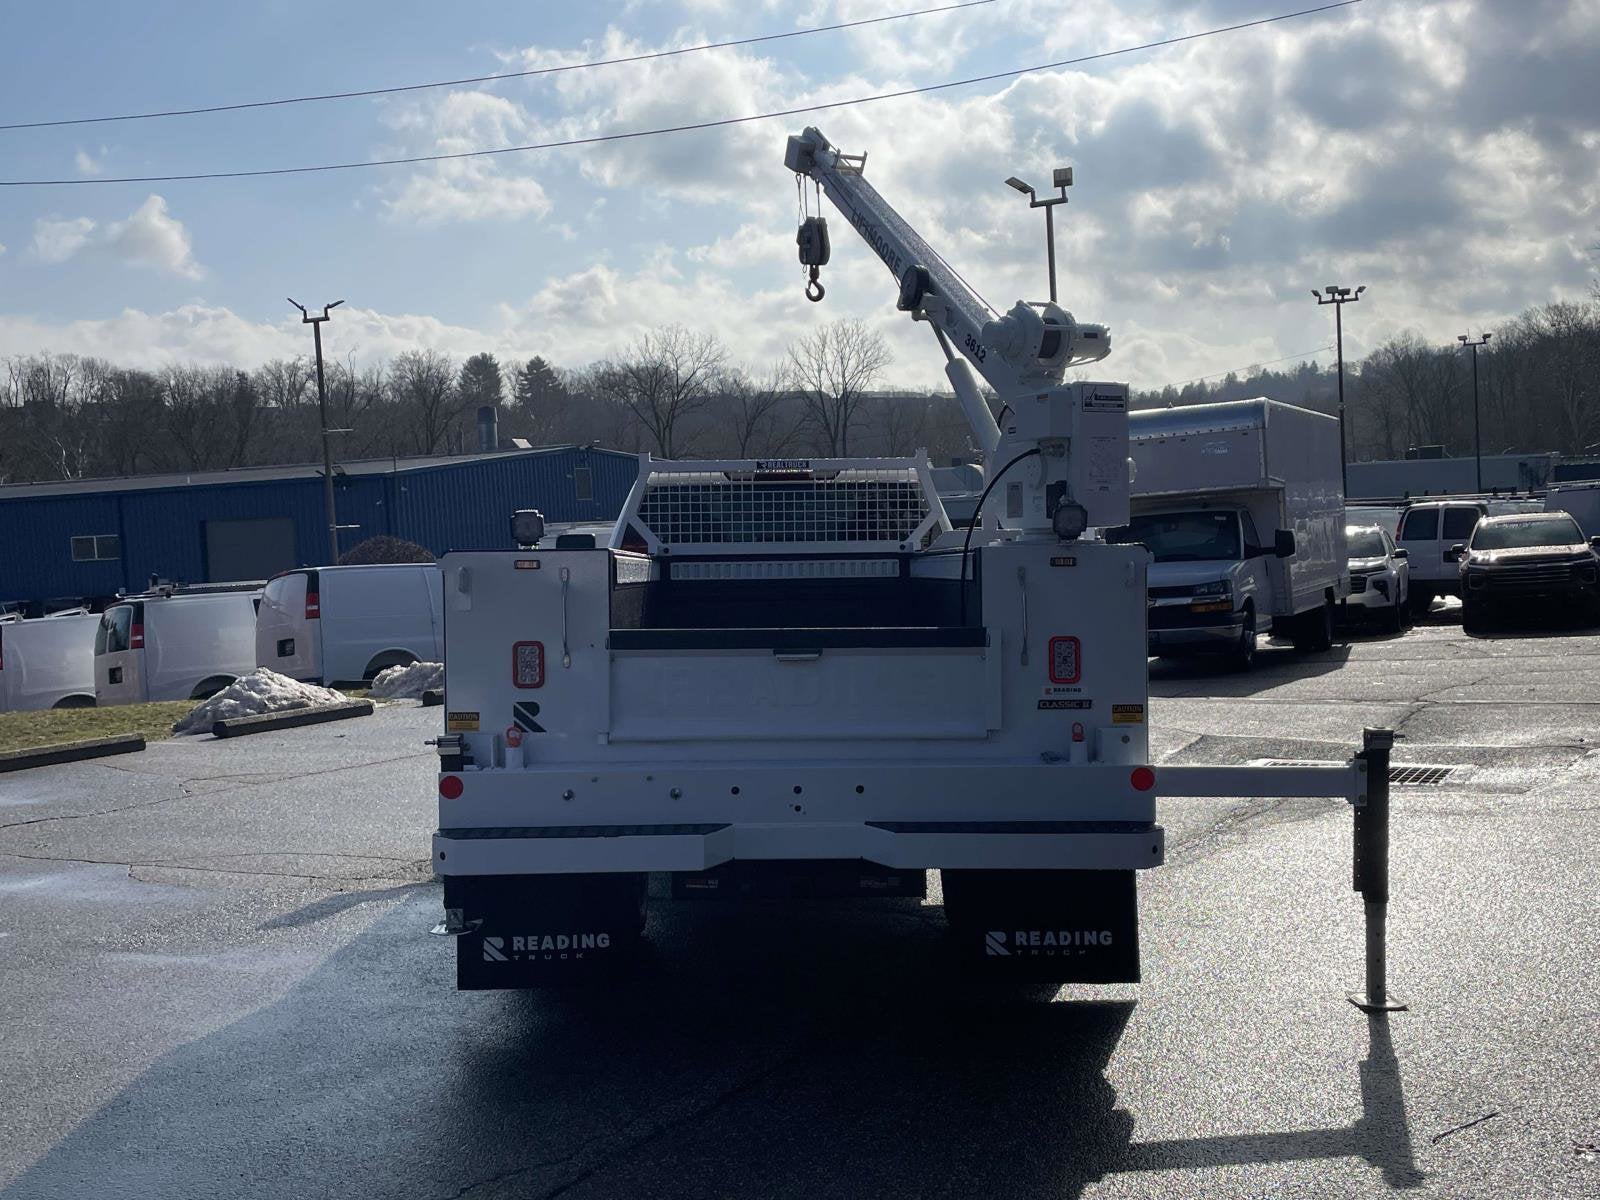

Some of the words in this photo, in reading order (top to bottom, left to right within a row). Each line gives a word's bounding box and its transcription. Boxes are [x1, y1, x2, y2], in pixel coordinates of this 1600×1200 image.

[964, 333, 986, 364] 3612
[1039, 700, 1081, 709] CLASSIC
[1113, 704, 1143, 713] CAUTION
[448, 712, 480, 721] CAUTION
[512, 933, 611, 951] READING
[1015, 930, 1113, 946] READING
[512, 953, 585, 961] TRUCK
